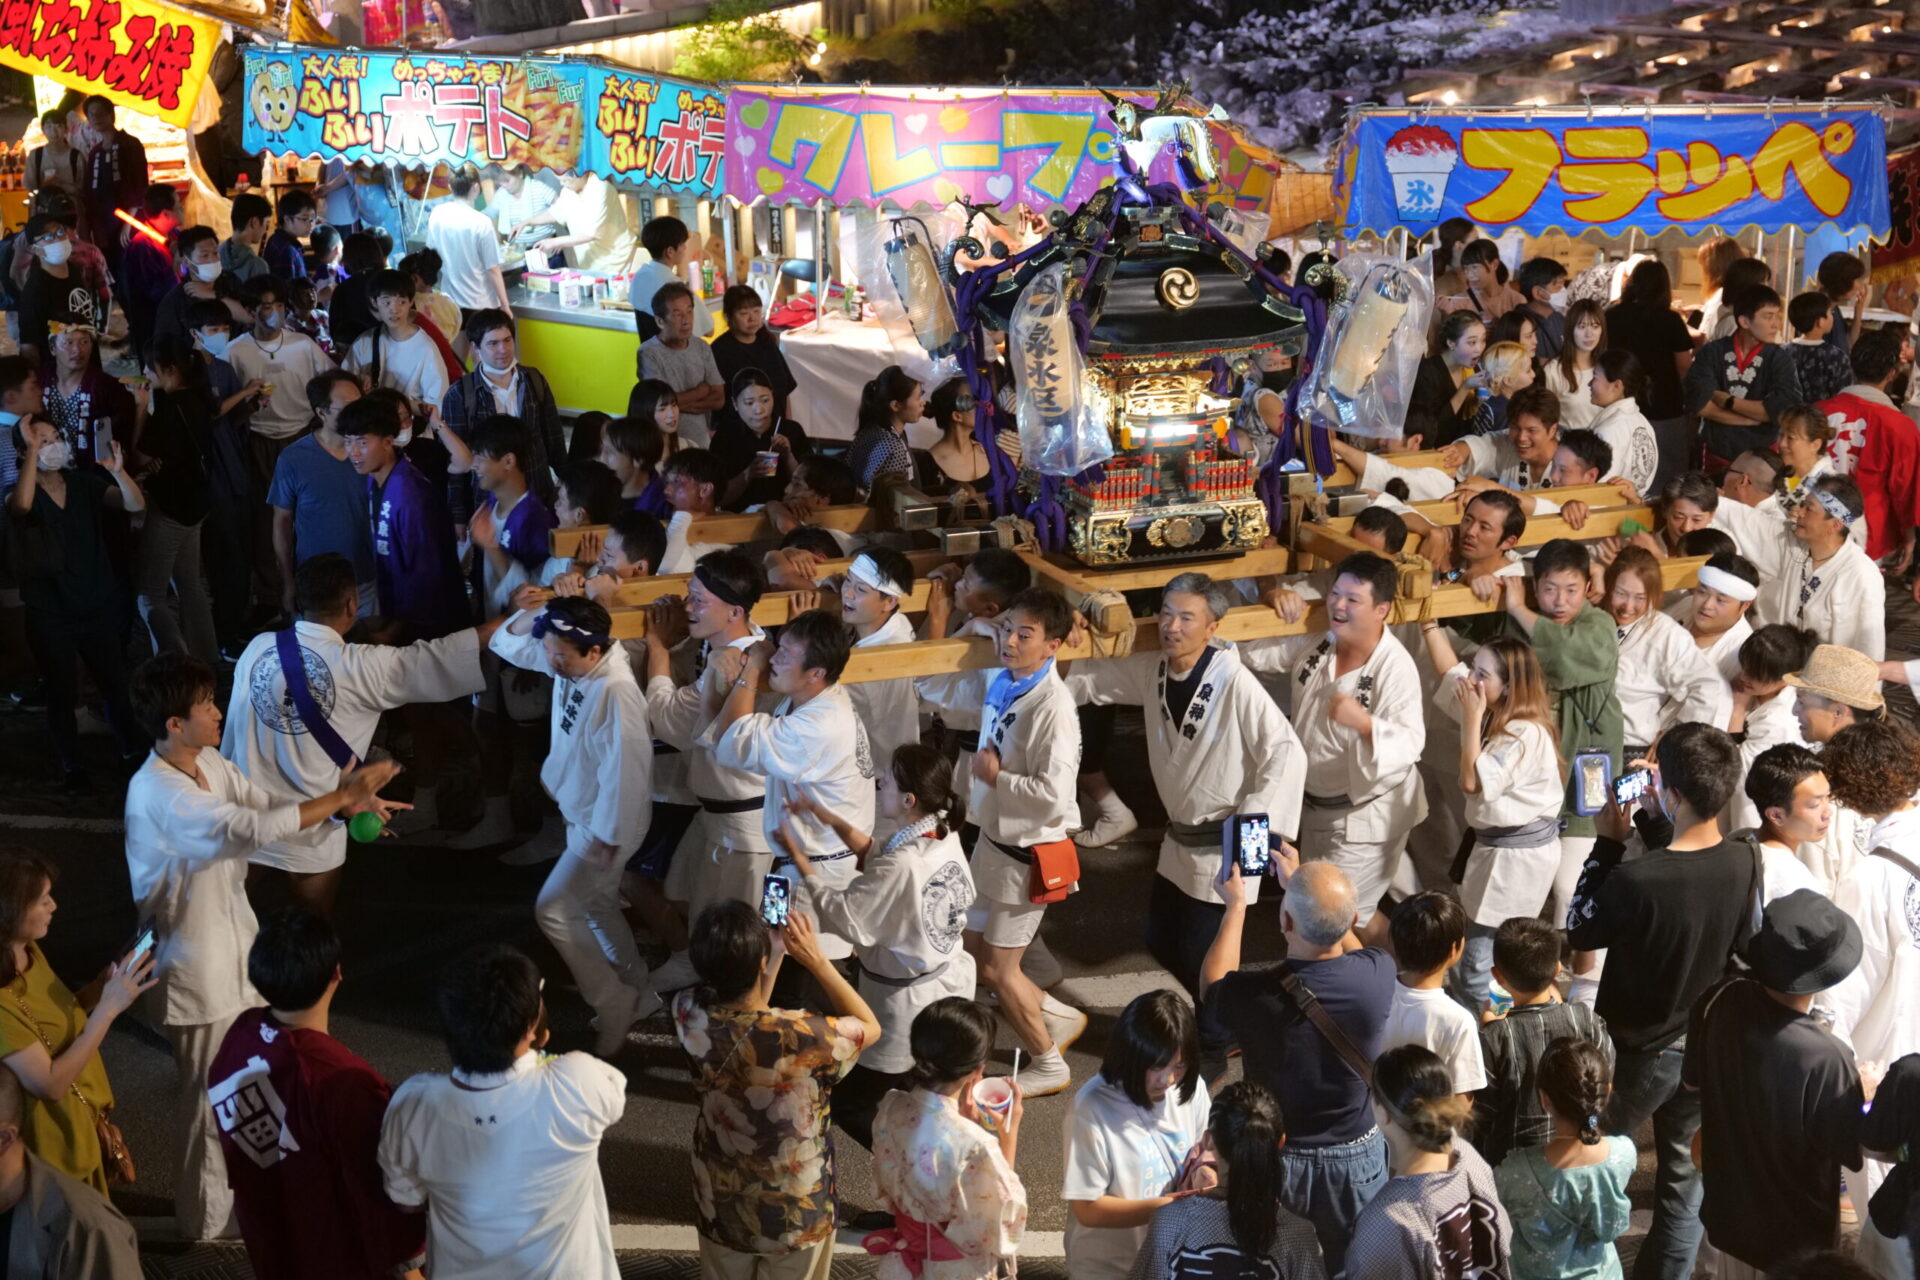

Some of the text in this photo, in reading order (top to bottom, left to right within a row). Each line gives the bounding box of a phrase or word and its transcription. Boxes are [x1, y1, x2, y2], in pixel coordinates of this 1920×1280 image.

[245, 54, 267, 76] Furi
[527, 67, 585, 104] Furi Furi
[381, 81, 532, 160] ポテト
[768, 102, 1115, 202] クレープ
[1405, 179, 1435, 207] 氷
[1460, 120, 1855, 223] フラッペ
[1025, 322, 1063, 413] 泉水区
